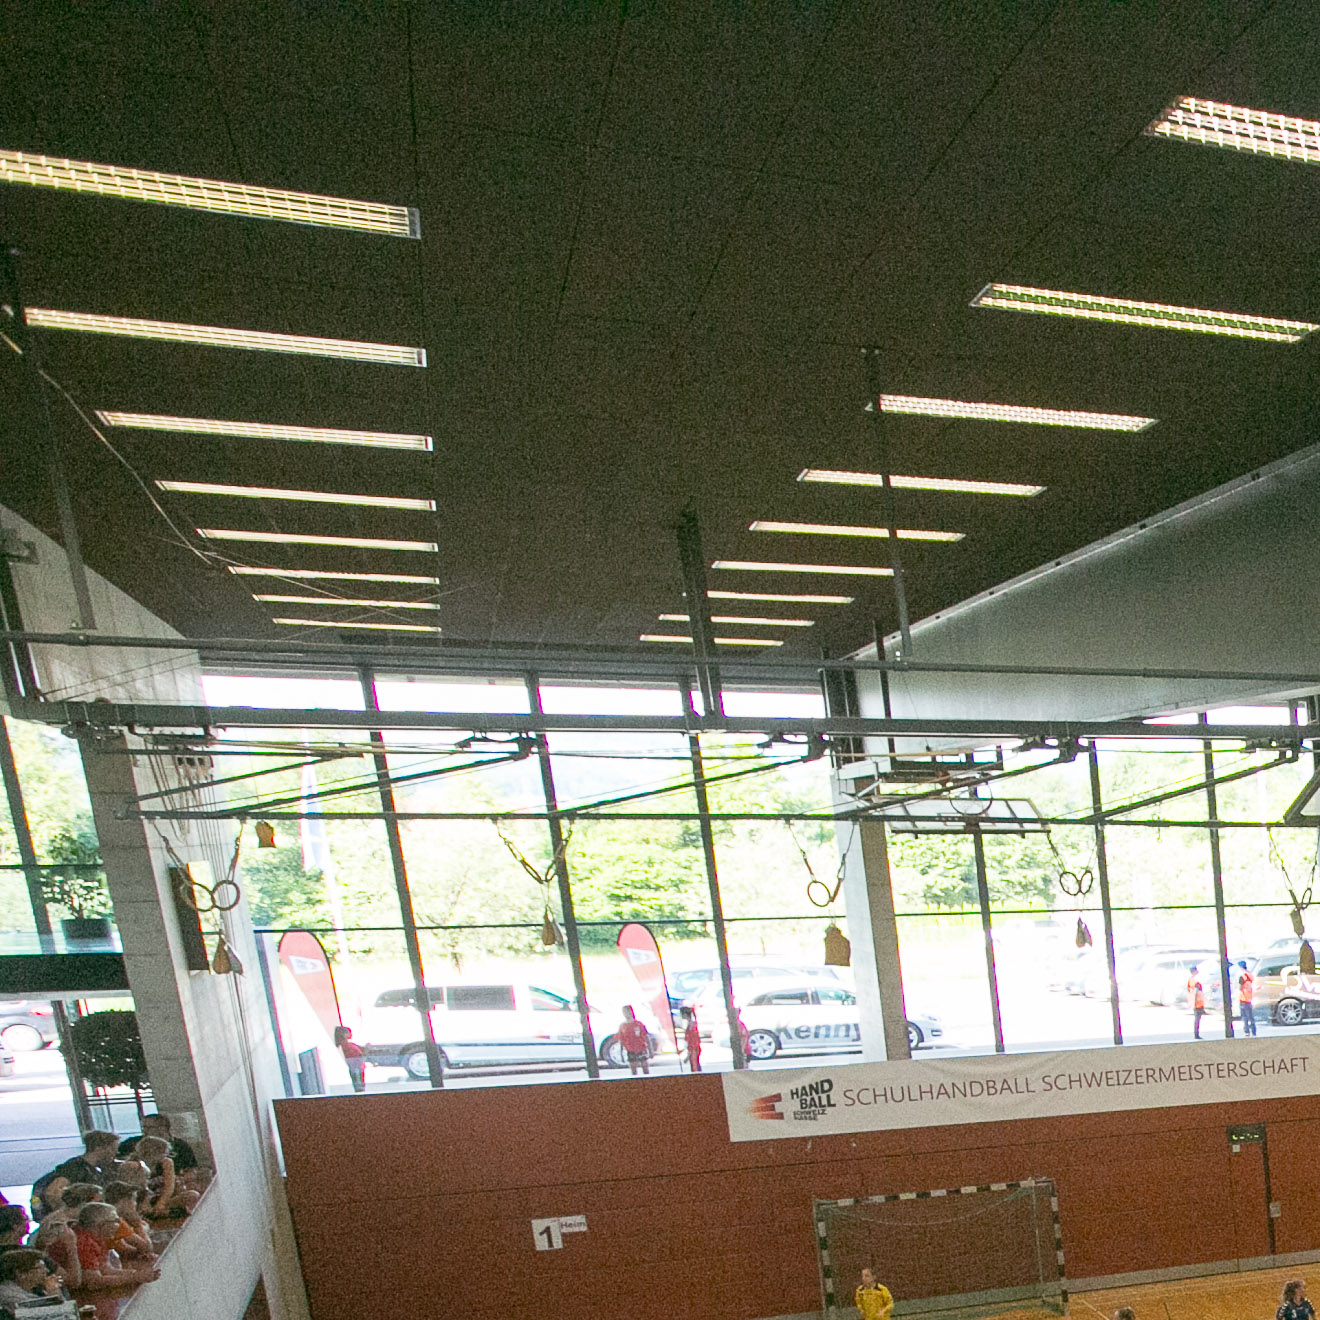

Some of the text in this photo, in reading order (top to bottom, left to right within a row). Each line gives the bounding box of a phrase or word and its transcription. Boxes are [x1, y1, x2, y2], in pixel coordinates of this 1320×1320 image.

[791, 1078, 834, 1100] HAND
[843, 1056, 1310, 1107] SCHULHANDBALL SCHWEIZERMEISTERSCHAFT
[800, 1094, 837, 1110] BALL
[539, 1220, 586, 1248] 1 Heim
